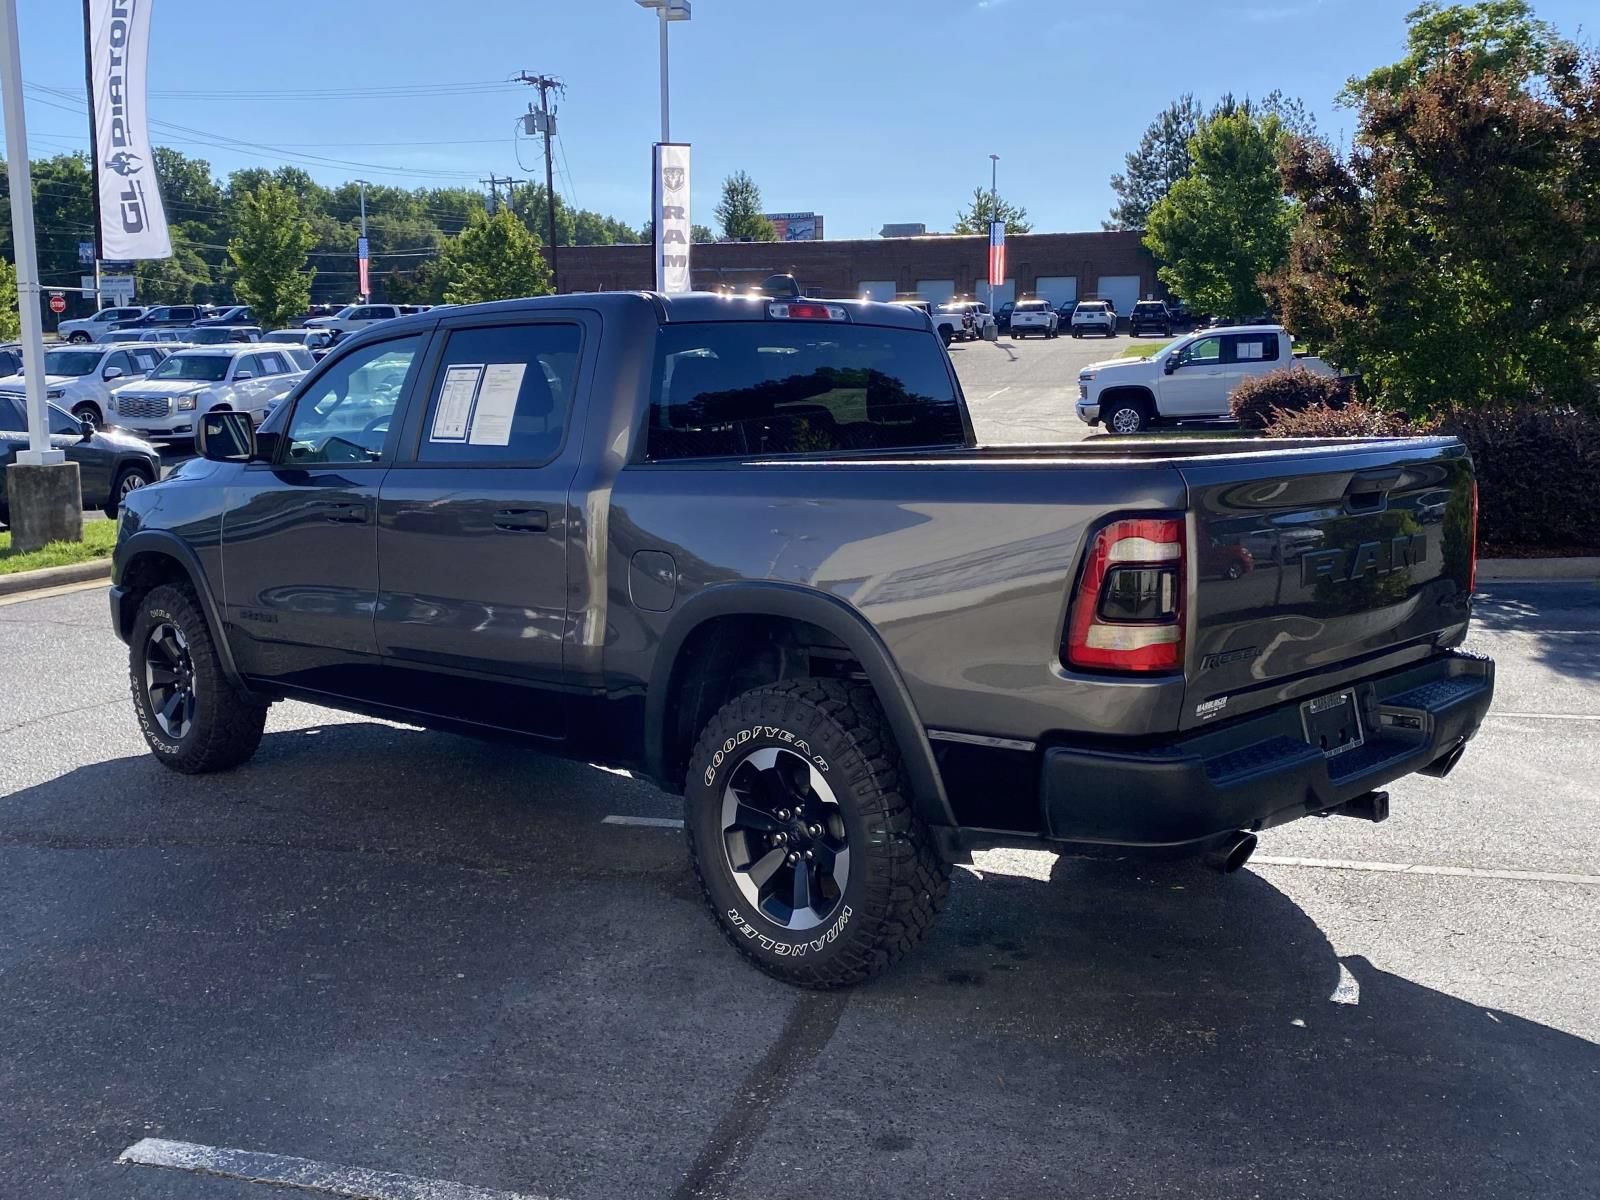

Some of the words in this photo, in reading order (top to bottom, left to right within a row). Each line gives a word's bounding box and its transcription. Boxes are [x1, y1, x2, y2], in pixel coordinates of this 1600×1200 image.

[662, 205, 688, 268] RAM
[1300, 534, 1427, 588] RAM
[704, 725, 829, 786] GOODYEAR
[727, 905, 852, 957] WRANGLER
